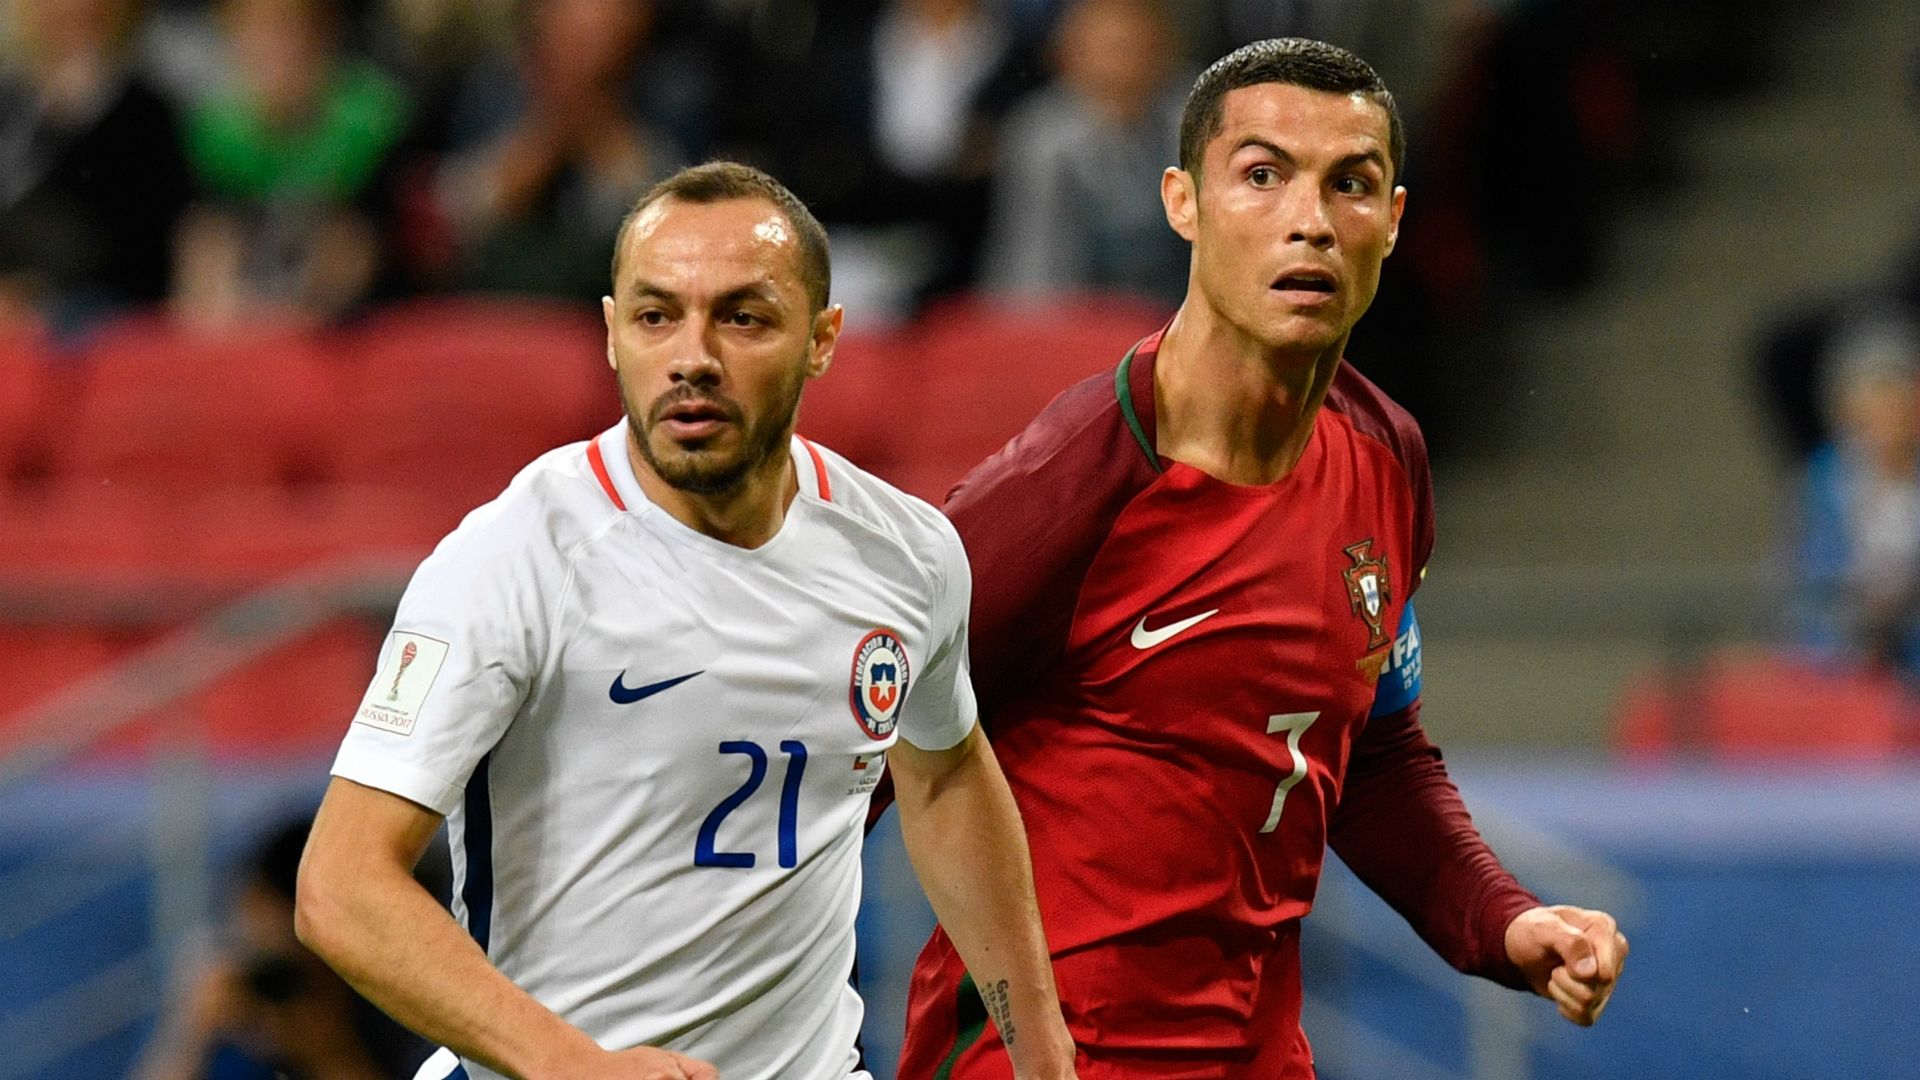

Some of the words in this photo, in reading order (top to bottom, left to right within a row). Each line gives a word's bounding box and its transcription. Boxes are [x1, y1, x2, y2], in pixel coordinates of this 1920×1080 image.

[389, 714, 413, 729] 2017
[1258, 711, 1322, 833] 7
[694, 740, 808, 869] 21
